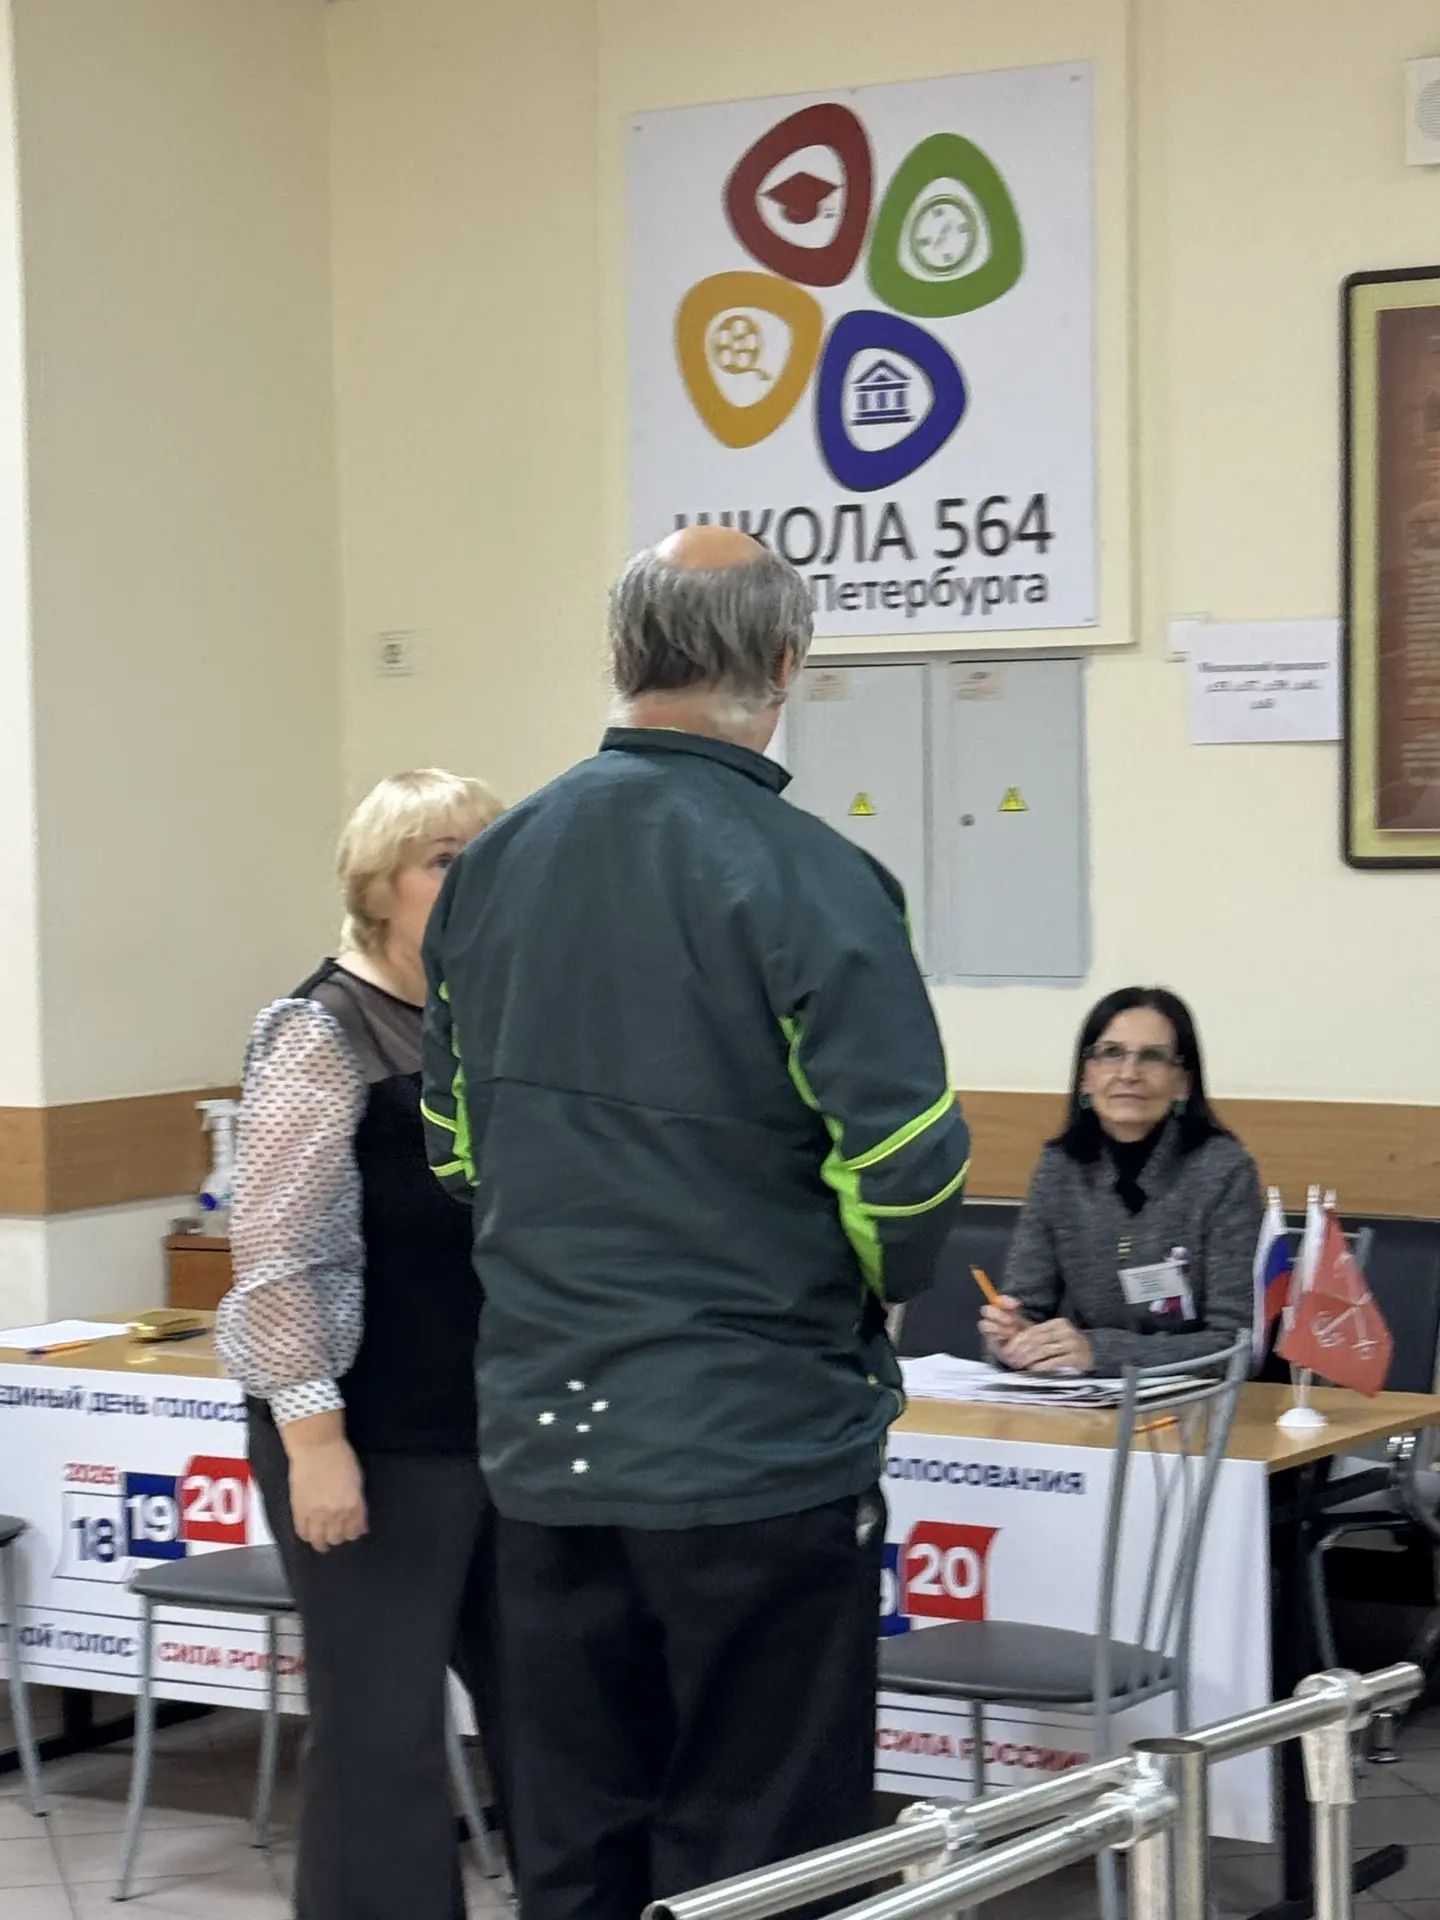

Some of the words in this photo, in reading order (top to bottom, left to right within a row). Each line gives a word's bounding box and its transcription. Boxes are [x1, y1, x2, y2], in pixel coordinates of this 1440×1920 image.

[934, 493, 1055, 558] 564
[87, 1392, 149, 1415] ДЕНЬ
[71, 1516, 115, 1562] 18
[125, 1494, 177, 1542] 19
[182, 1475, 244, 1525] 20
[906, 1542, 981, 1599] 20
[57, 1630, 137, 1657] ГОЛОС
